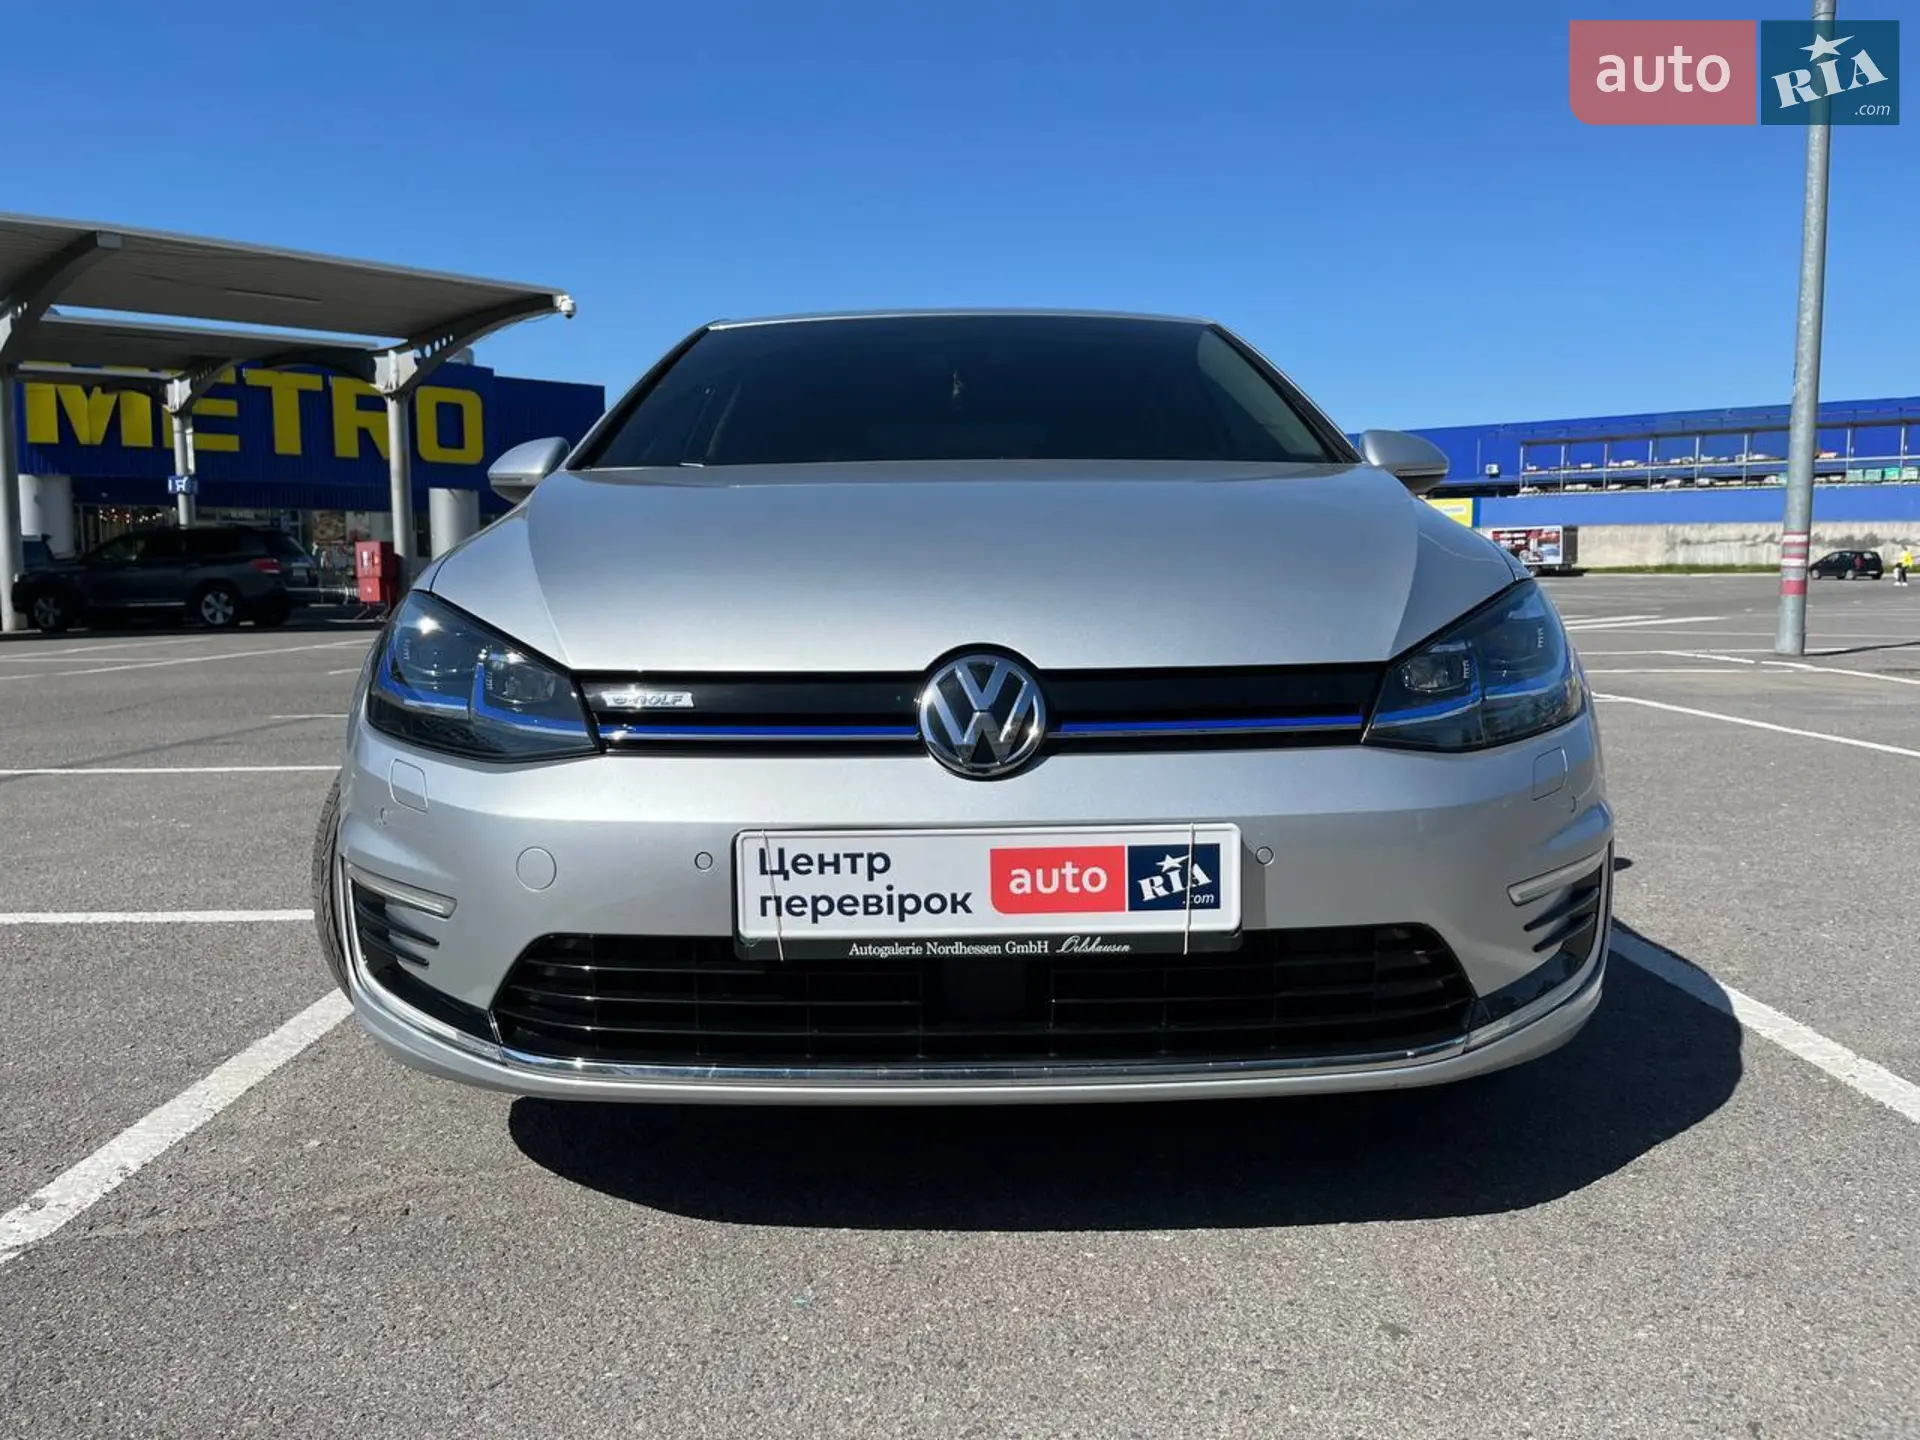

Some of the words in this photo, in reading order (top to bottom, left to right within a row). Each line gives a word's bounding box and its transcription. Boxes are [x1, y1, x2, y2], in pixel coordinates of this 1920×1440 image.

[19, 361, 484, 465] METRO
[758, 847, 891, 881] Центр
[1009, 861, 1108, 894] auto
[1137, 863, 1213, 901] RIA
[759, 884, 973, 924] перевірок
[849, 942, 923, 958] Autogalerie
[925, 941, 1001, 955] Nordhessen
[1005, 940, 1048, 954] GmbH
